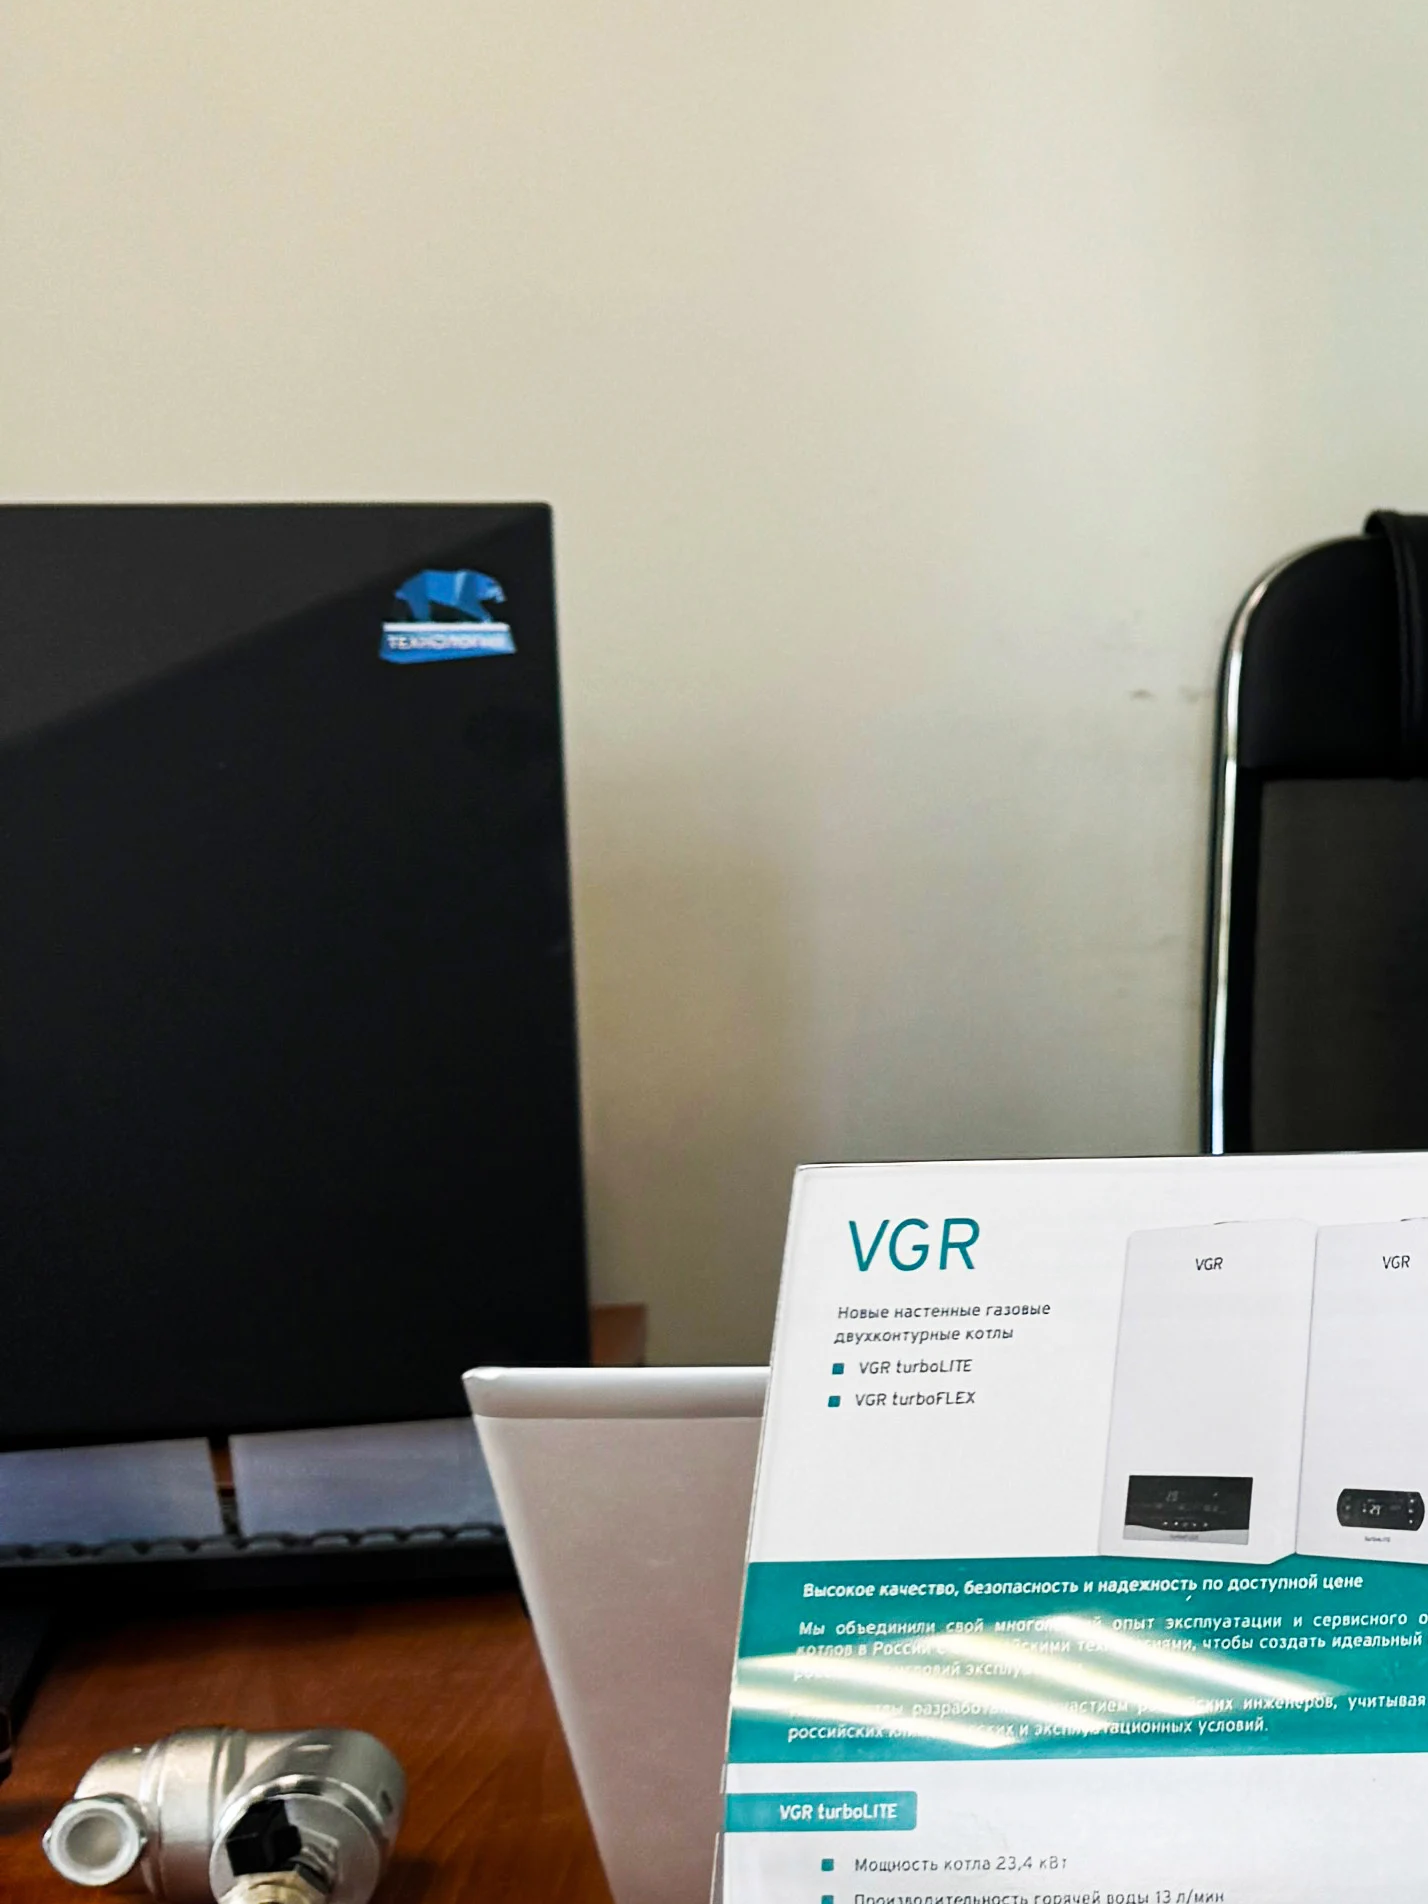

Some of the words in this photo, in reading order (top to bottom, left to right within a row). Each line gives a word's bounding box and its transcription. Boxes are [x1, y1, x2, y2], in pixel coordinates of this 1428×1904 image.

[848, 1217, 981, 1272] VGR
[1195, 1256, 1224, 1271] VGR
[1382, 1254, 1411, 1270] VGR
[837, 1306, 890, 1320] Новые
[893, 1305, 981, 1319] настенные
[985, 1304, 1051, 1317] газовые
[833, 1329, 961, 1346] двухконтурные
[965, 1328, 1014, 1340] котлы
[859, 1360, 892, 1375] VGR
[895, 1358, 973, 1374] turboLITE
[855, 1392, 888, 1407] VGR
[892, 1390, 976, 1406] turboFLEX
[802, 1582, 876, 1598] Высокое
[878, 1583, 960, 1597] качество,
[963, 1579, 1079, 1595] безопасность
[1083, 1580, 1094, 1593] и
[1097, 1578, 1198, 1595] надежность
[1202, 1578, 1224, 1591] по
[1226, 1573, 1319, 1593] доступной
[1322, 1575, 1364, 1591] цене
[779, 1803, 814, 1822] VGR
[816, 1802, 898, 1821] turboLITE
